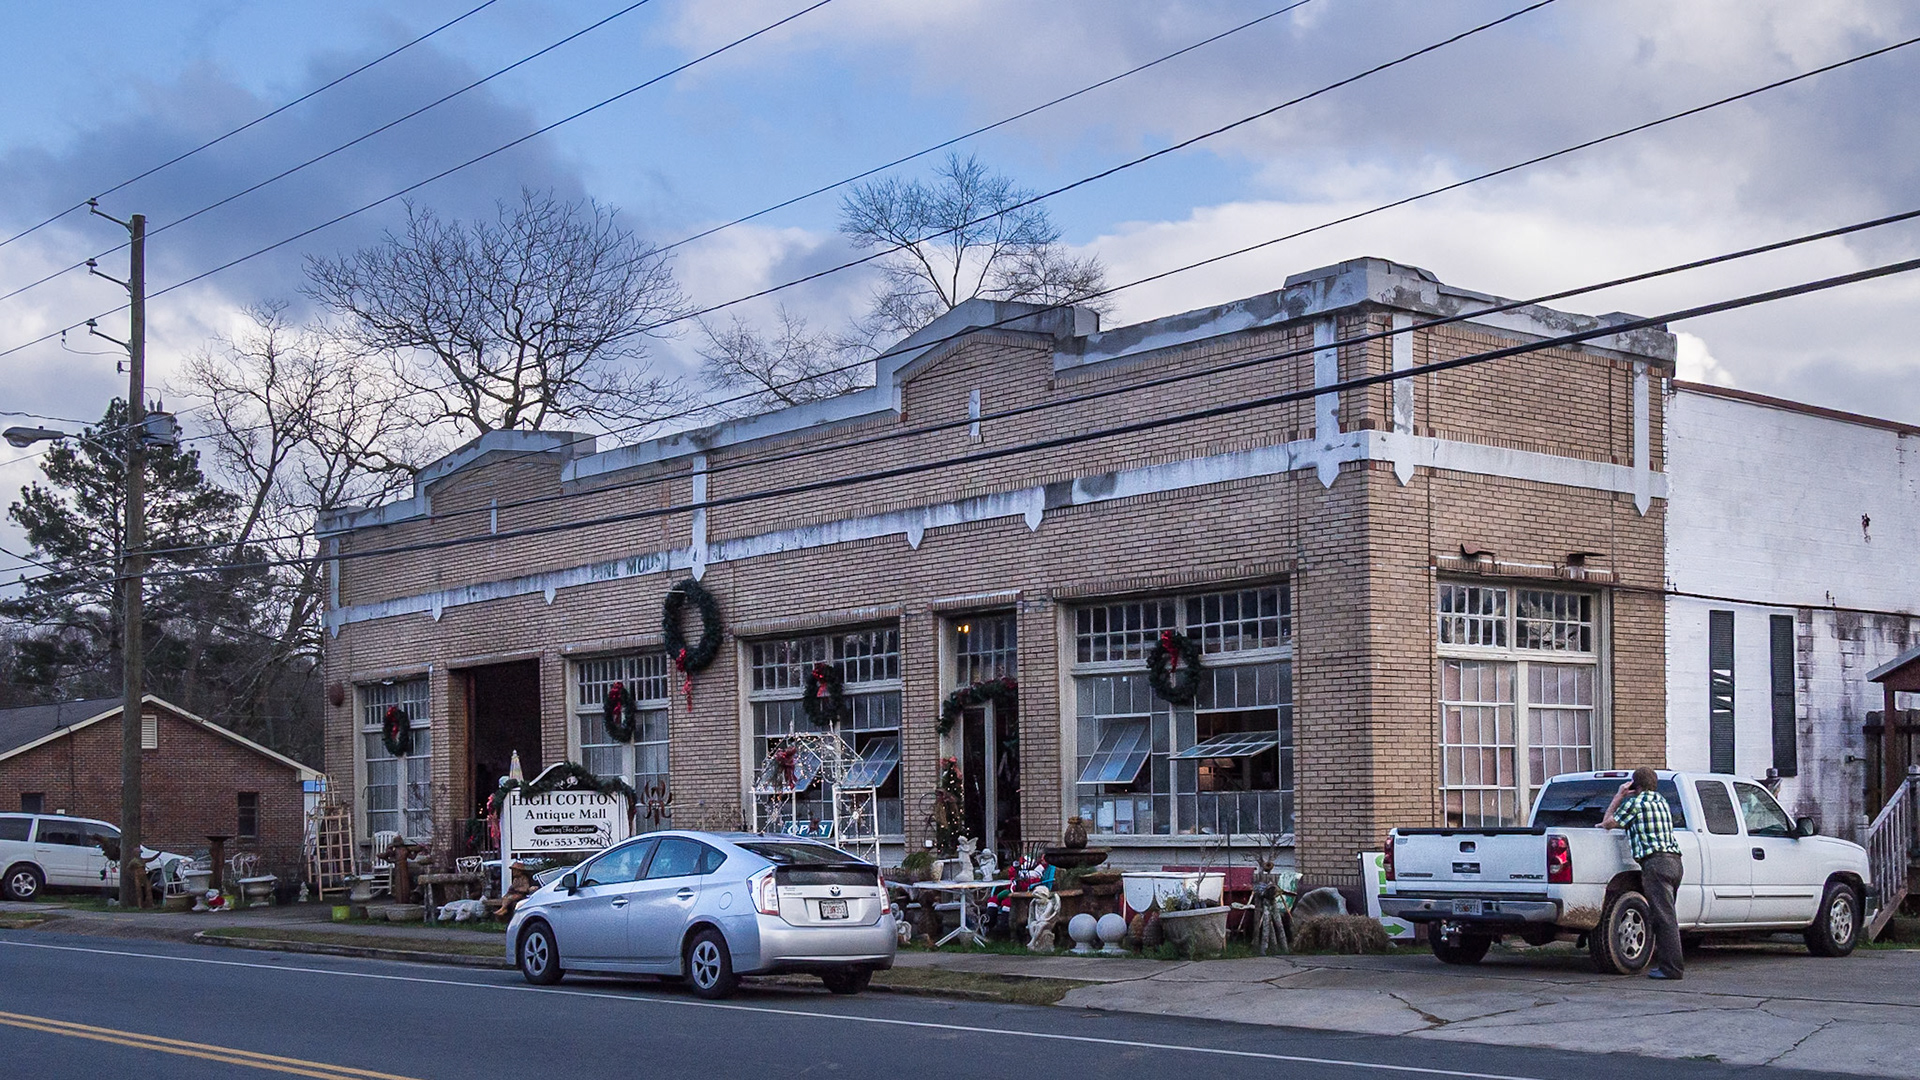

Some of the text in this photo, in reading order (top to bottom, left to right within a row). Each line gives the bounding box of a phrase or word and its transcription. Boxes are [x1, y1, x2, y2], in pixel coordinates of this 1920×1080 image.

[556, 794, 618, 805] COTTON
[525, 809, 606, 822] Antique Mall
